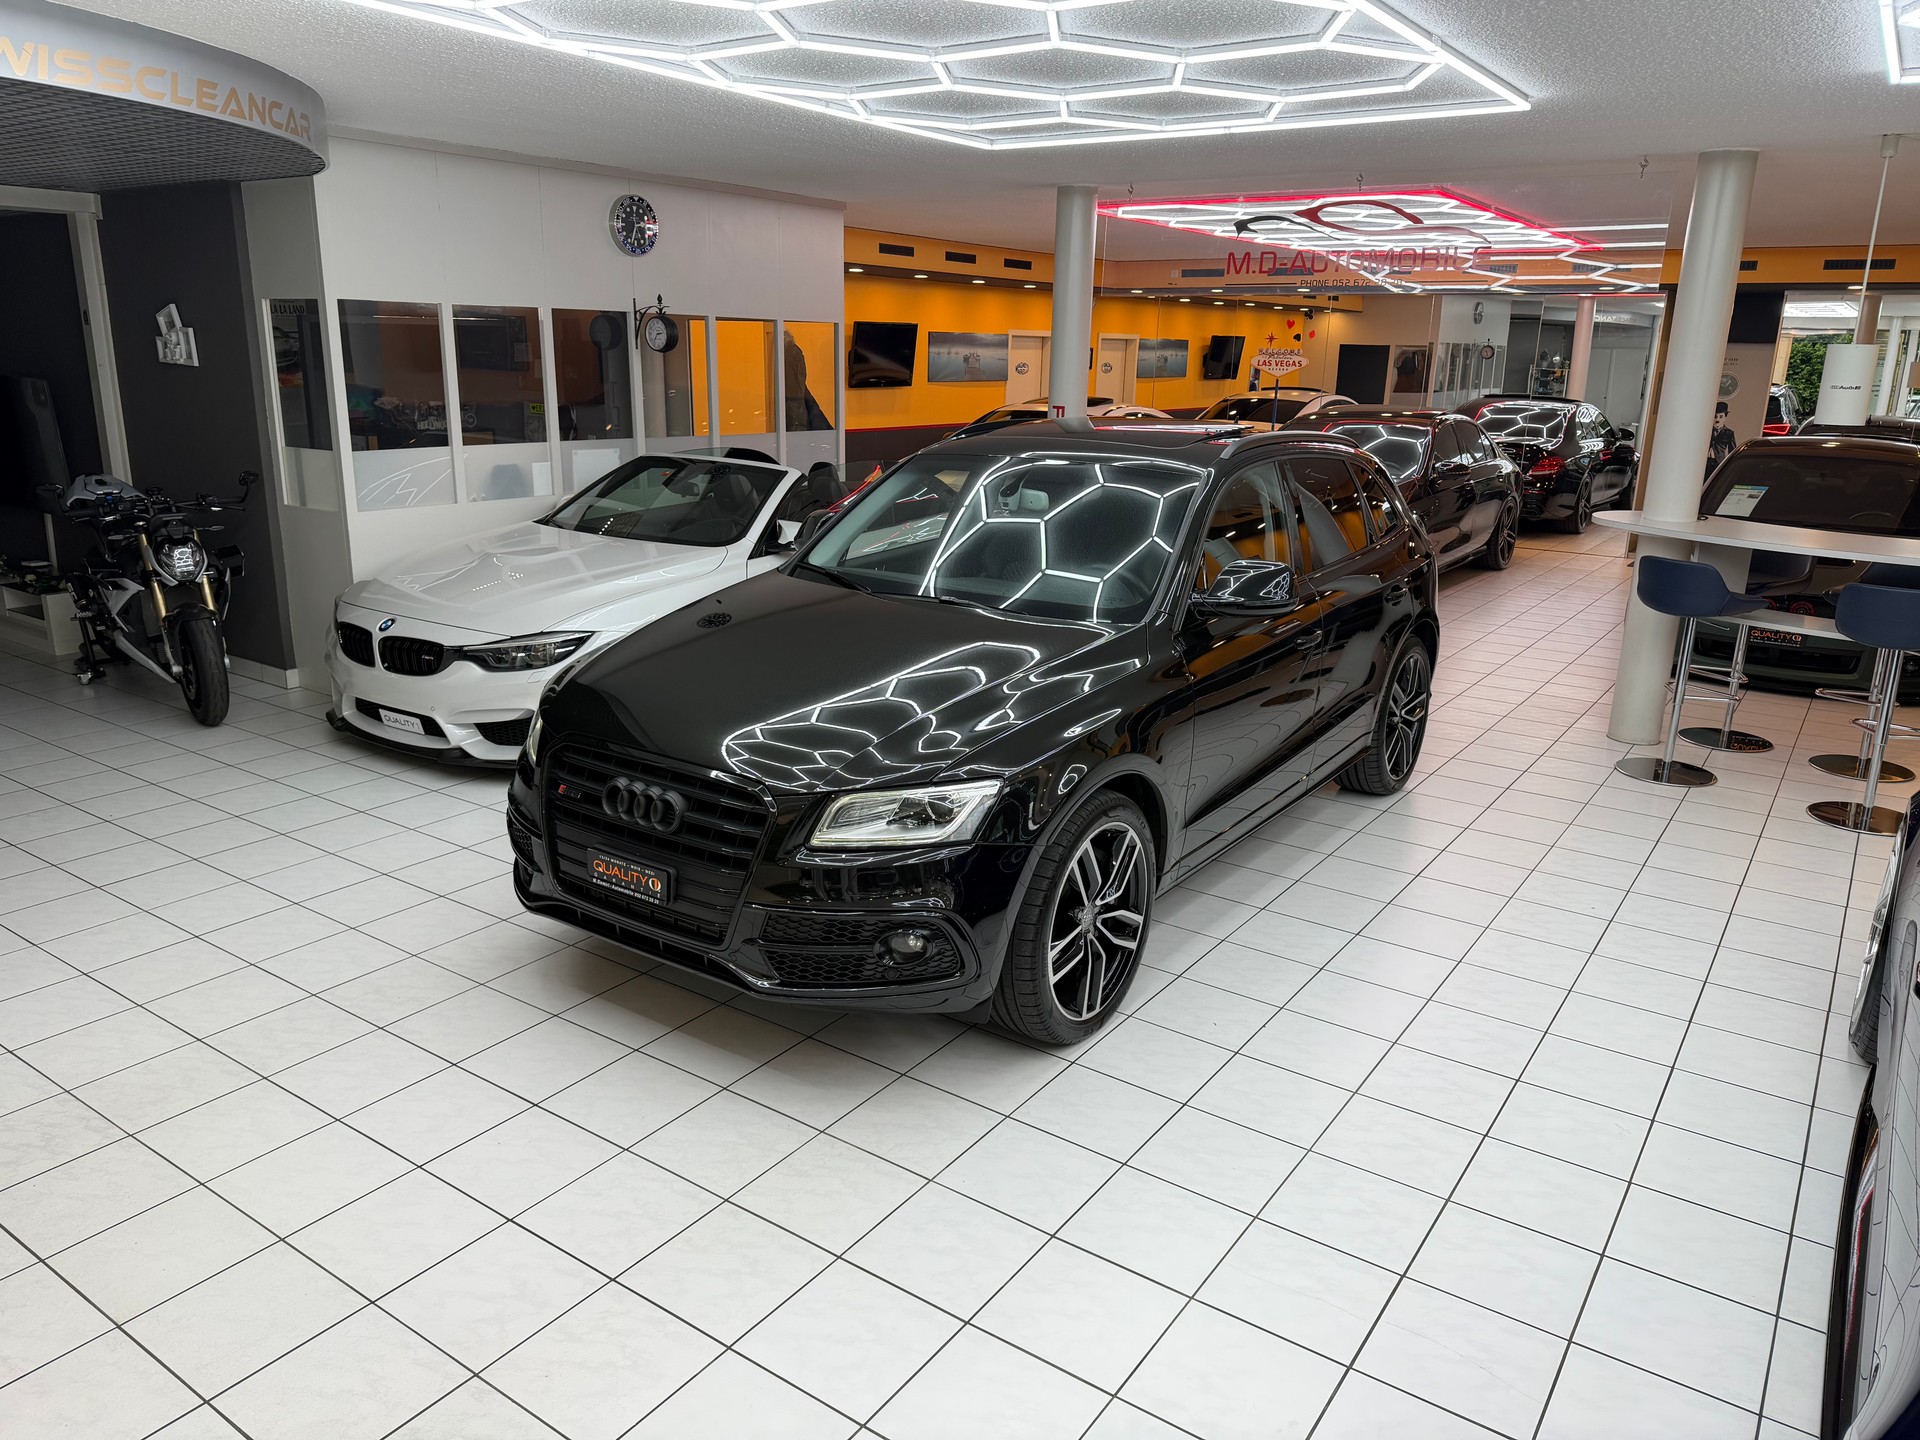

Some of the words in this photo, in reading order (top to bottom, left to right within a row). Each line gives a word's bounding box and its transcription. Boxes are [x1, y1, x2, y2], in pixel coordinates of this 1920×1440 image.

[1300, 279, 1329, 287] PHONE
[1332, 278, 1350, 287] 052
[280, 304, 287, 314] LA
[288, 304, 305, 315] LAND
[1257, 359, 1272, 367] LAS
[1275, 359, 1303, 368] VEGAS
[1751, 630, 1792, 640] QUALITY
[383, 714, 415, 728] QUALITY
[593, 860, 648, 887] QUALITY
